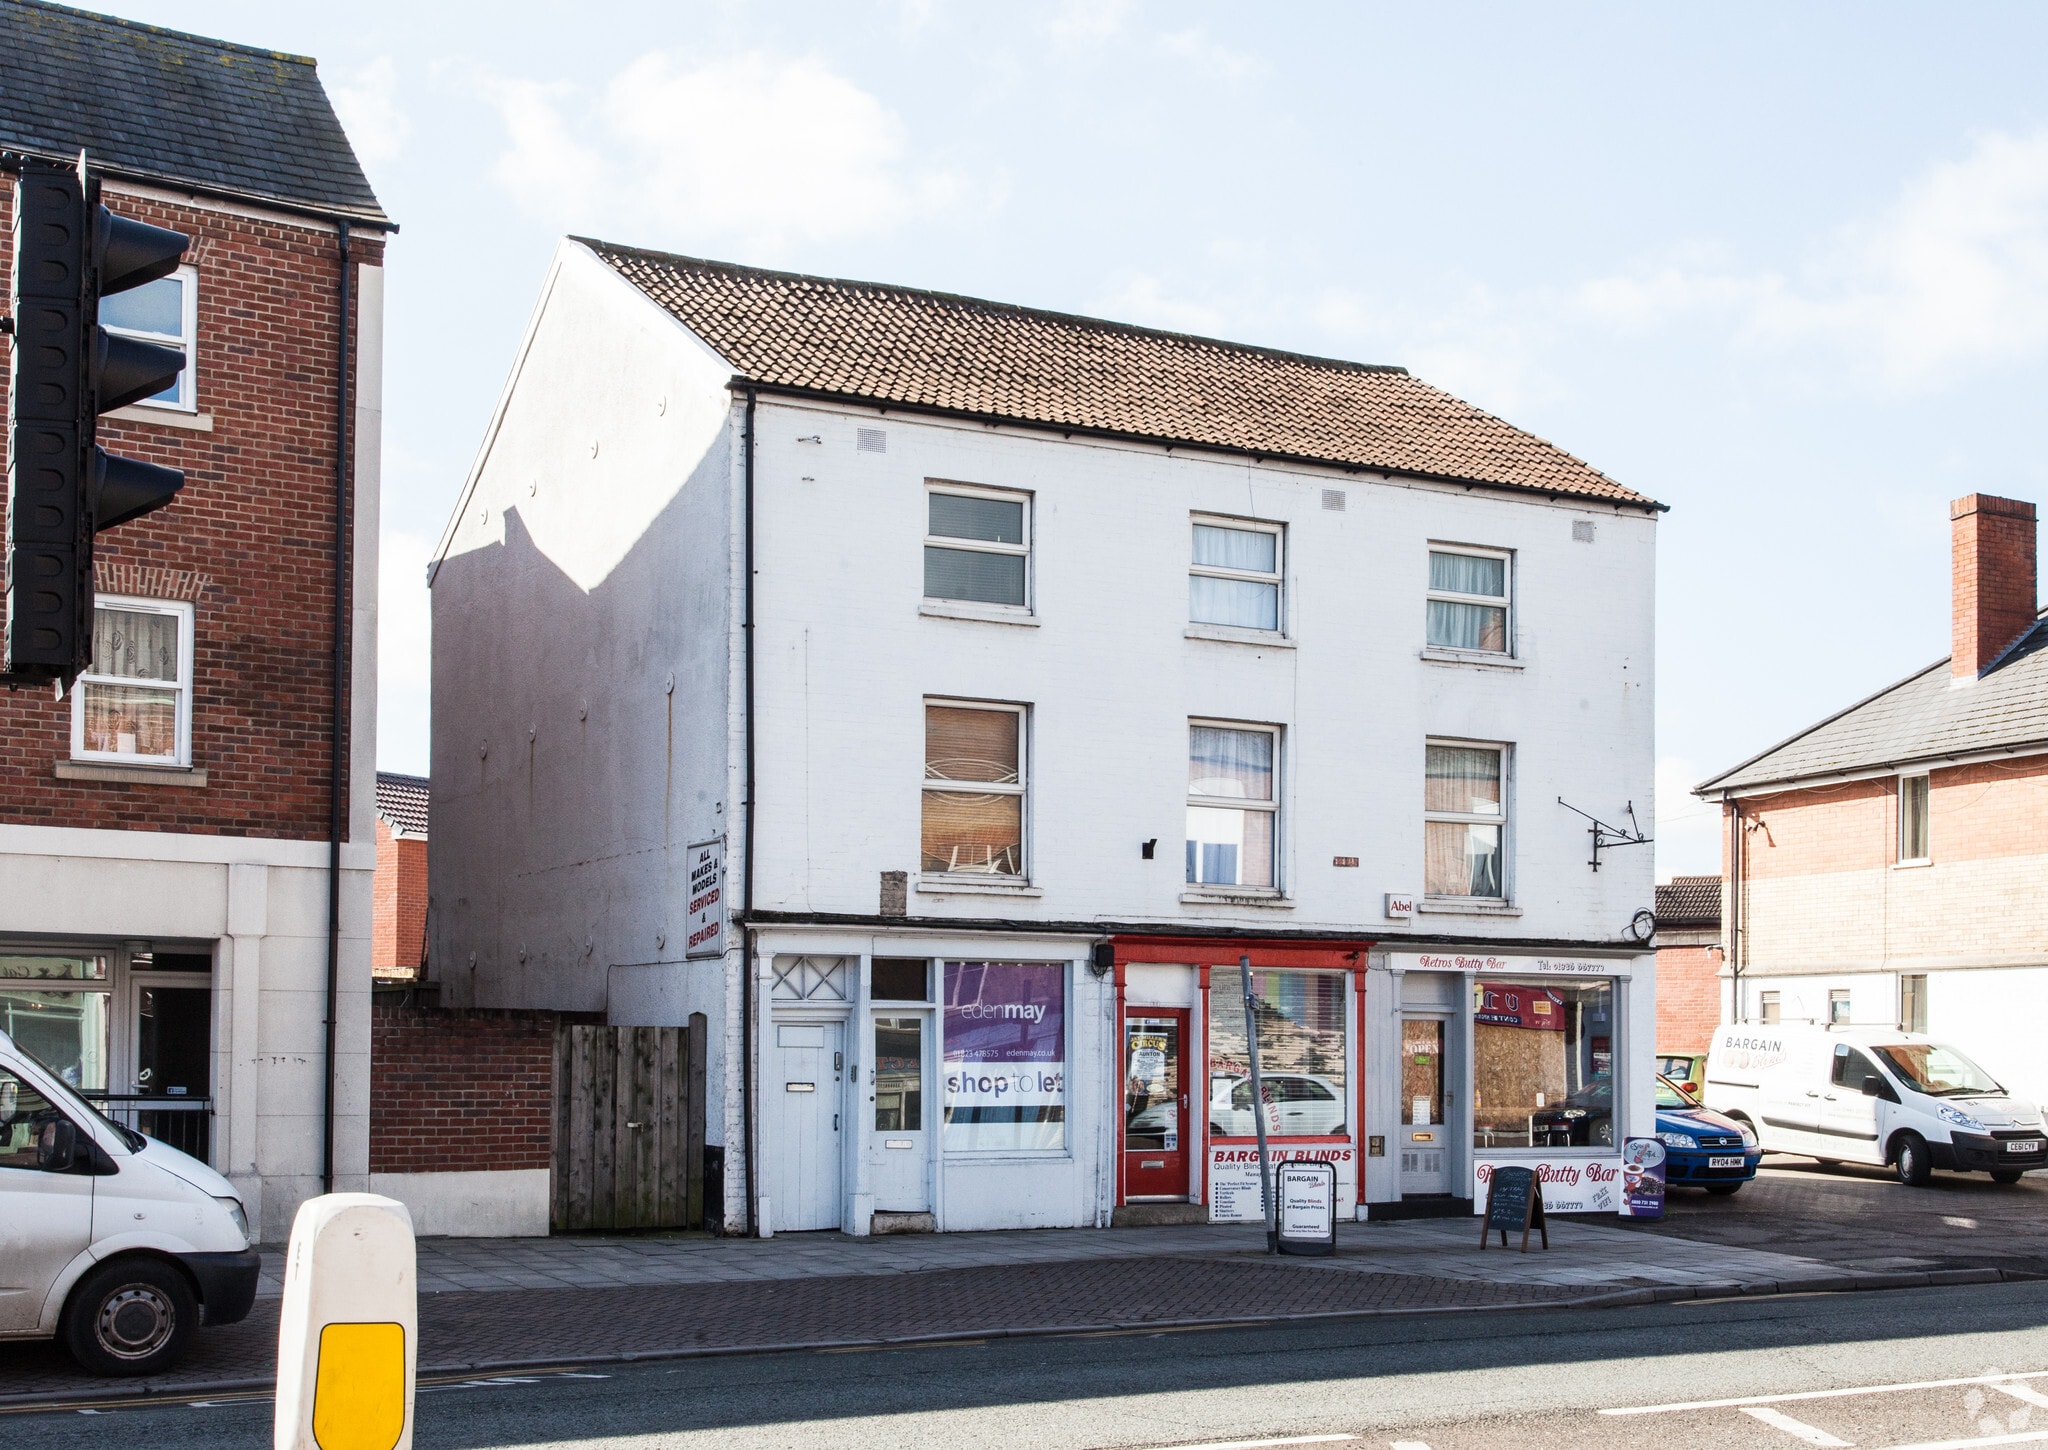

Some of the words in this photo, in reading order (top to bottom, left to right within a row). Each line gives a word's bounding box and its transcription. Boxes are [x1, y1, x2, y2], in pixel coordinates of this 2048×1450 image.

[699, 849, 711, 864] ALL
[691, 861, 712, 882] MAKES
[713, 858, 718, 870] &
[692, 873, 717, 895] MODELS
[689, 888, 720, 915] SERVICED
[1390, 900, 1412, 912] Abel
[701, 912, 706, 923] &
[688, 921, 719, 949] REPAIRED
[1454, 955, 1484, 971] Butty
[1486, 956, 1508, 969] Bar
[961, 999, 1046, 1024] edenmay
[1131, 1039, 1166, 1051] CIRCUS
[1409, 1044, 1439, 1054] OPEN
[1725, 1036, 1782, 1053] BARGAIN
[974, 1049, 999, 1058] 478575
[1006, 1049, 1056, 1059] edenmay.co.uk
[947, 1071, 1009, 1098] shop
[1011, 1072, 1034, 1093] to
[1037, 1070, 1063, 1093] let
[1261, 1086, 1281, 1132] BLINDS
[1214, 1150, 1288, 1163] BARGIN
[1294, 1149, 1352, 1162] BLINDS
[1213, 1163, 1241, 1171] Quality
[1535, 1163, 1582, 1187] Butty
[1585, 1162, 1620, 1183] Bar
